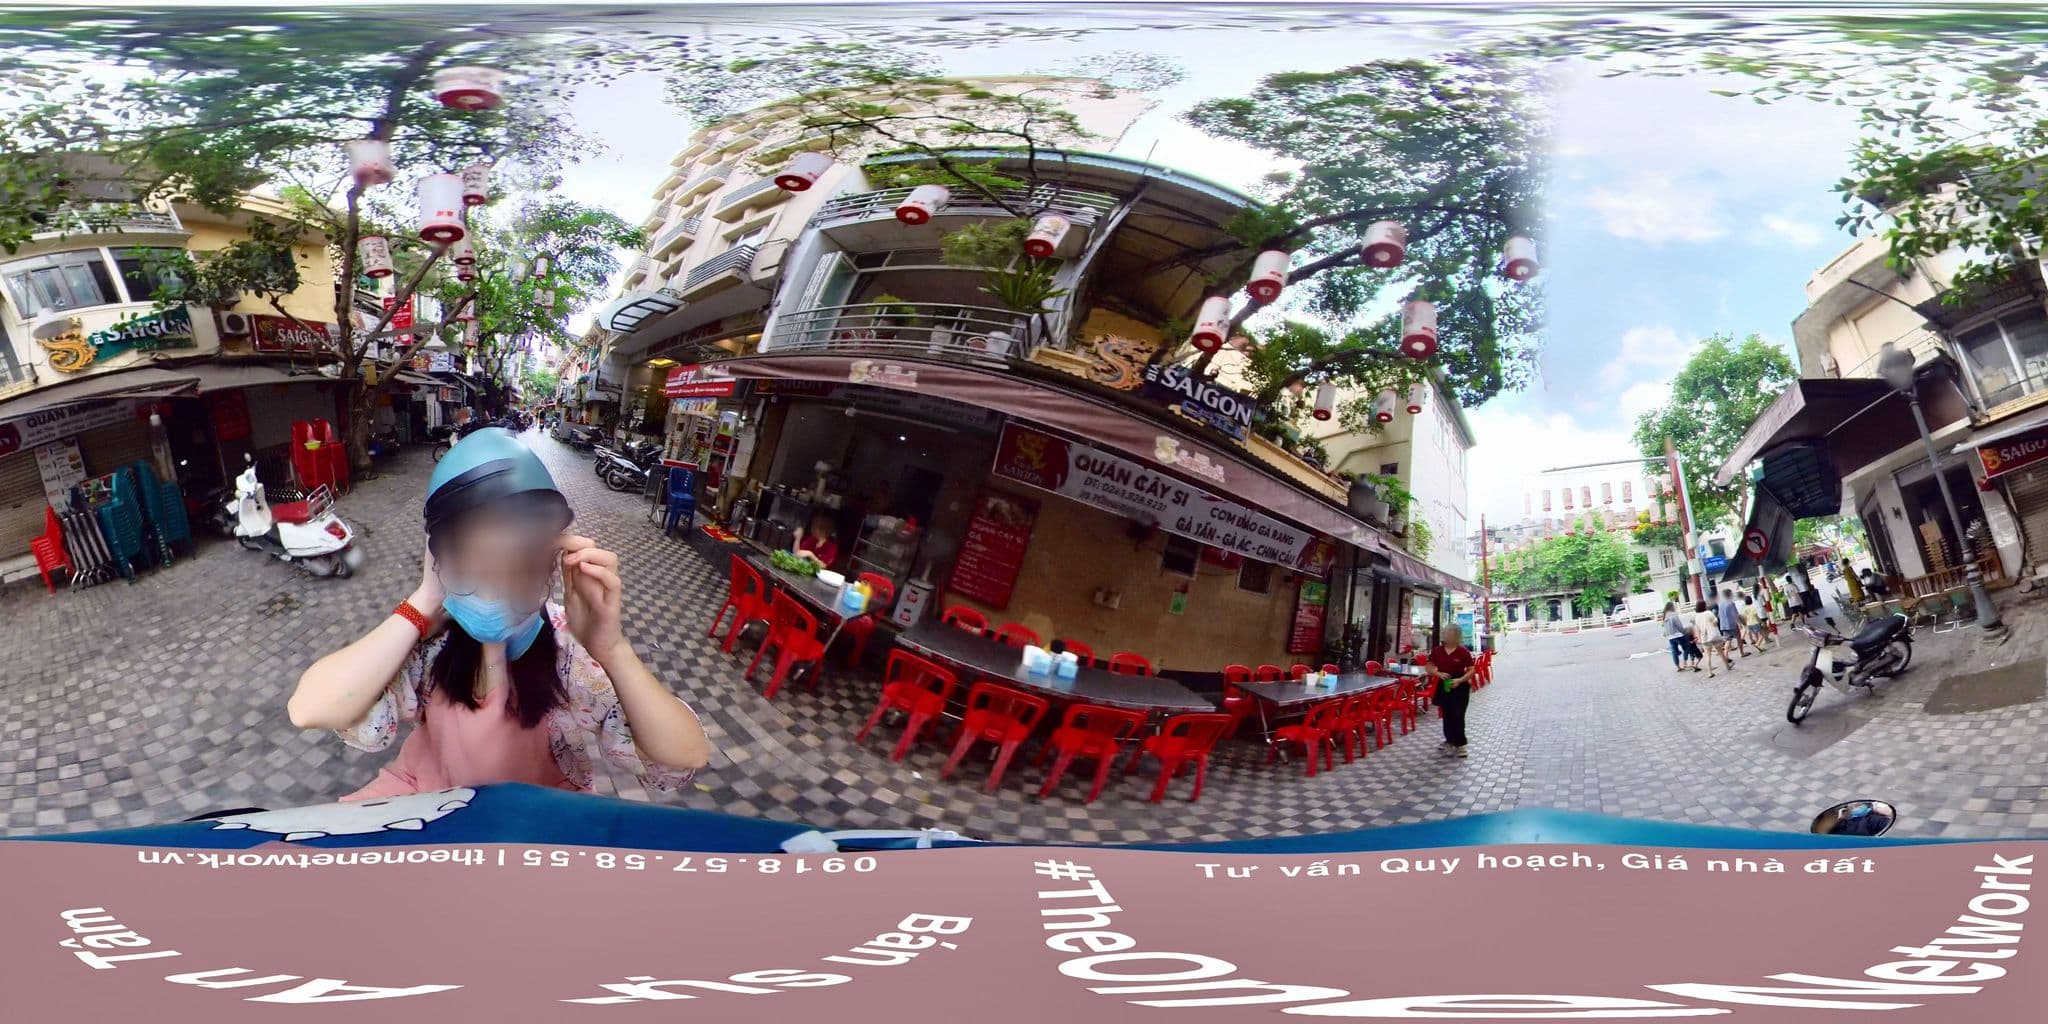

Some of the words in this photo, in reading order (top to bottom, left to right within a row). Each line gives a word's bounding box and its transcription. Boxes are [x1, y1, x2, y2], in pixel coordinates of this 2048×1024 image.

[1161, 364, 1252, 426] SAIGON
[1074, 454, 1132, 486] QUÁN
[1134, 475, 1172, 498] CÂY
[1172, 490, 1190, 507] SI
[1256, 544, 1279, 561] CHIM
[1271, 530, 1295, 546] RANG
